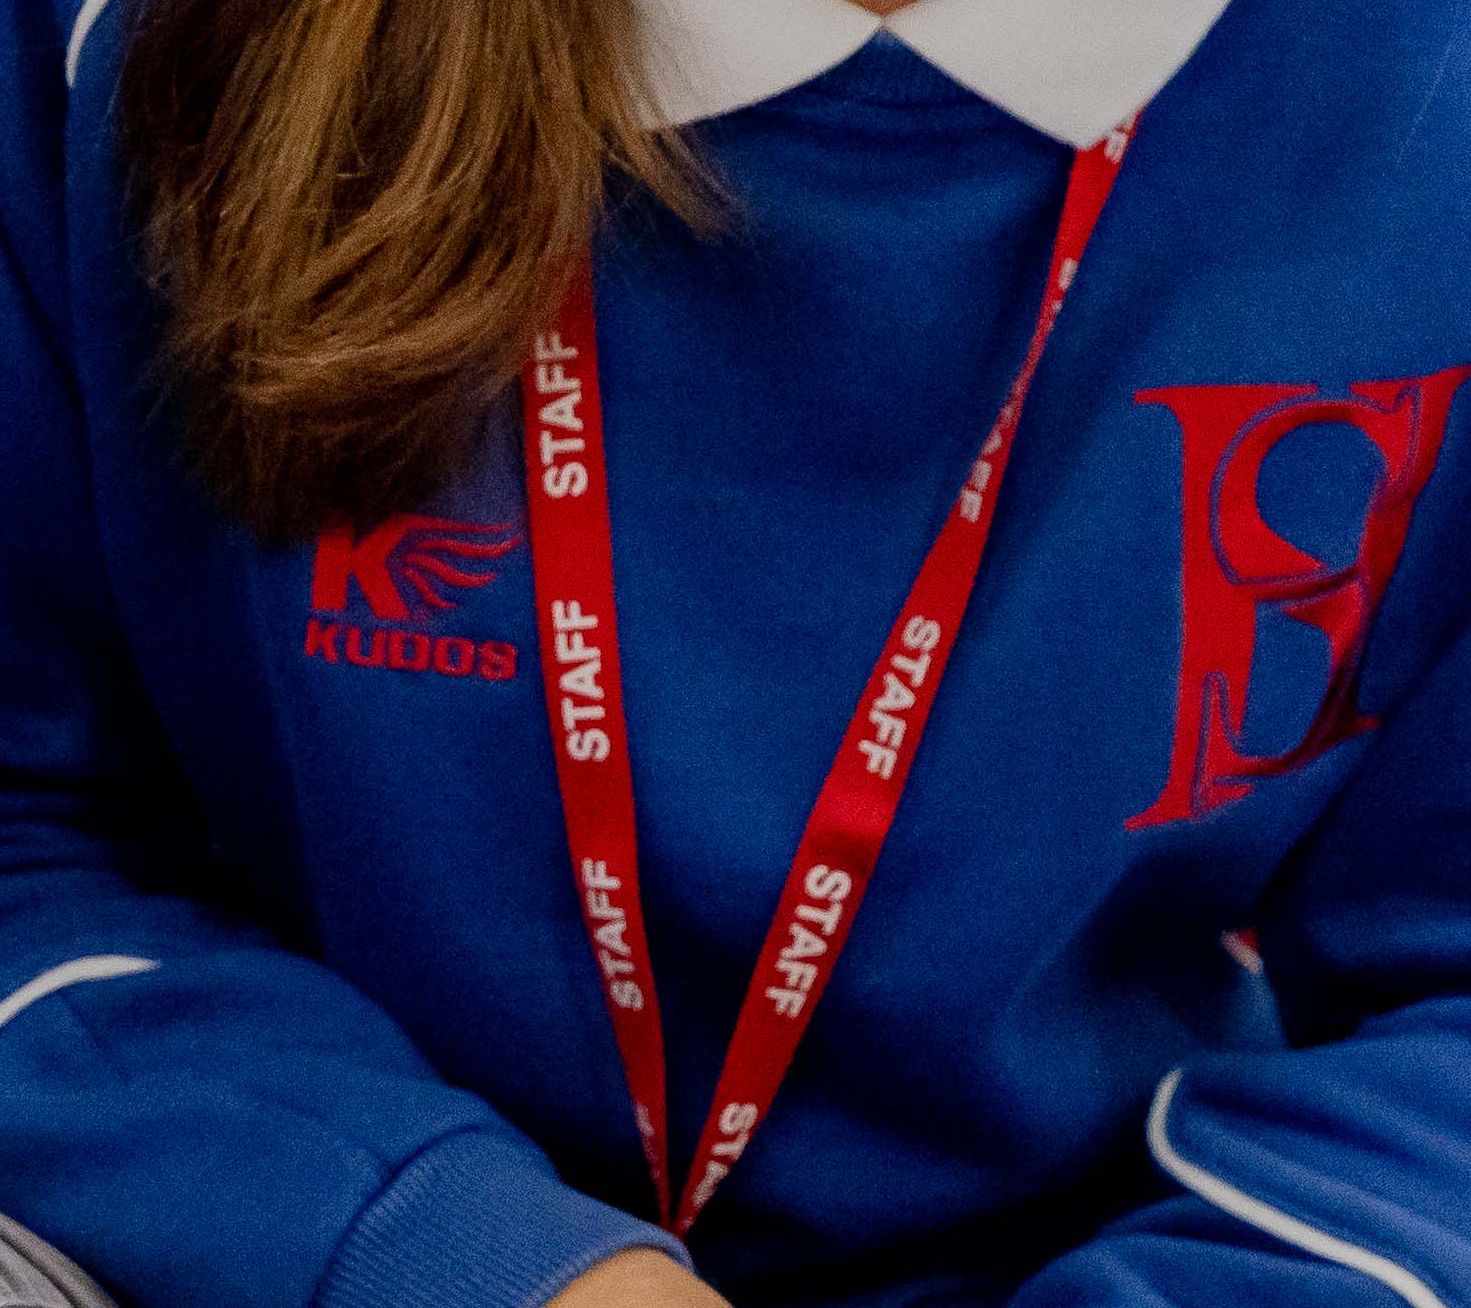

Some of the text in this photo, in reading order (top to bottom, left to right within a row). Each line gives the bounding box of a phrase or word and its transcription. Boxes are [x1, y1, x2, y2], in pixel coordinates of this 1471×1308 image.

[535, 330, 589, 499] STAFF
[305, 619, 519, 682] KUDOS
[551, 599, 611, 763] STAFF
[858, 614, 942, 780] STAFF
[581, 857, 645, 1012] STAFF
[764, 863, 853, 1019] STAFF
